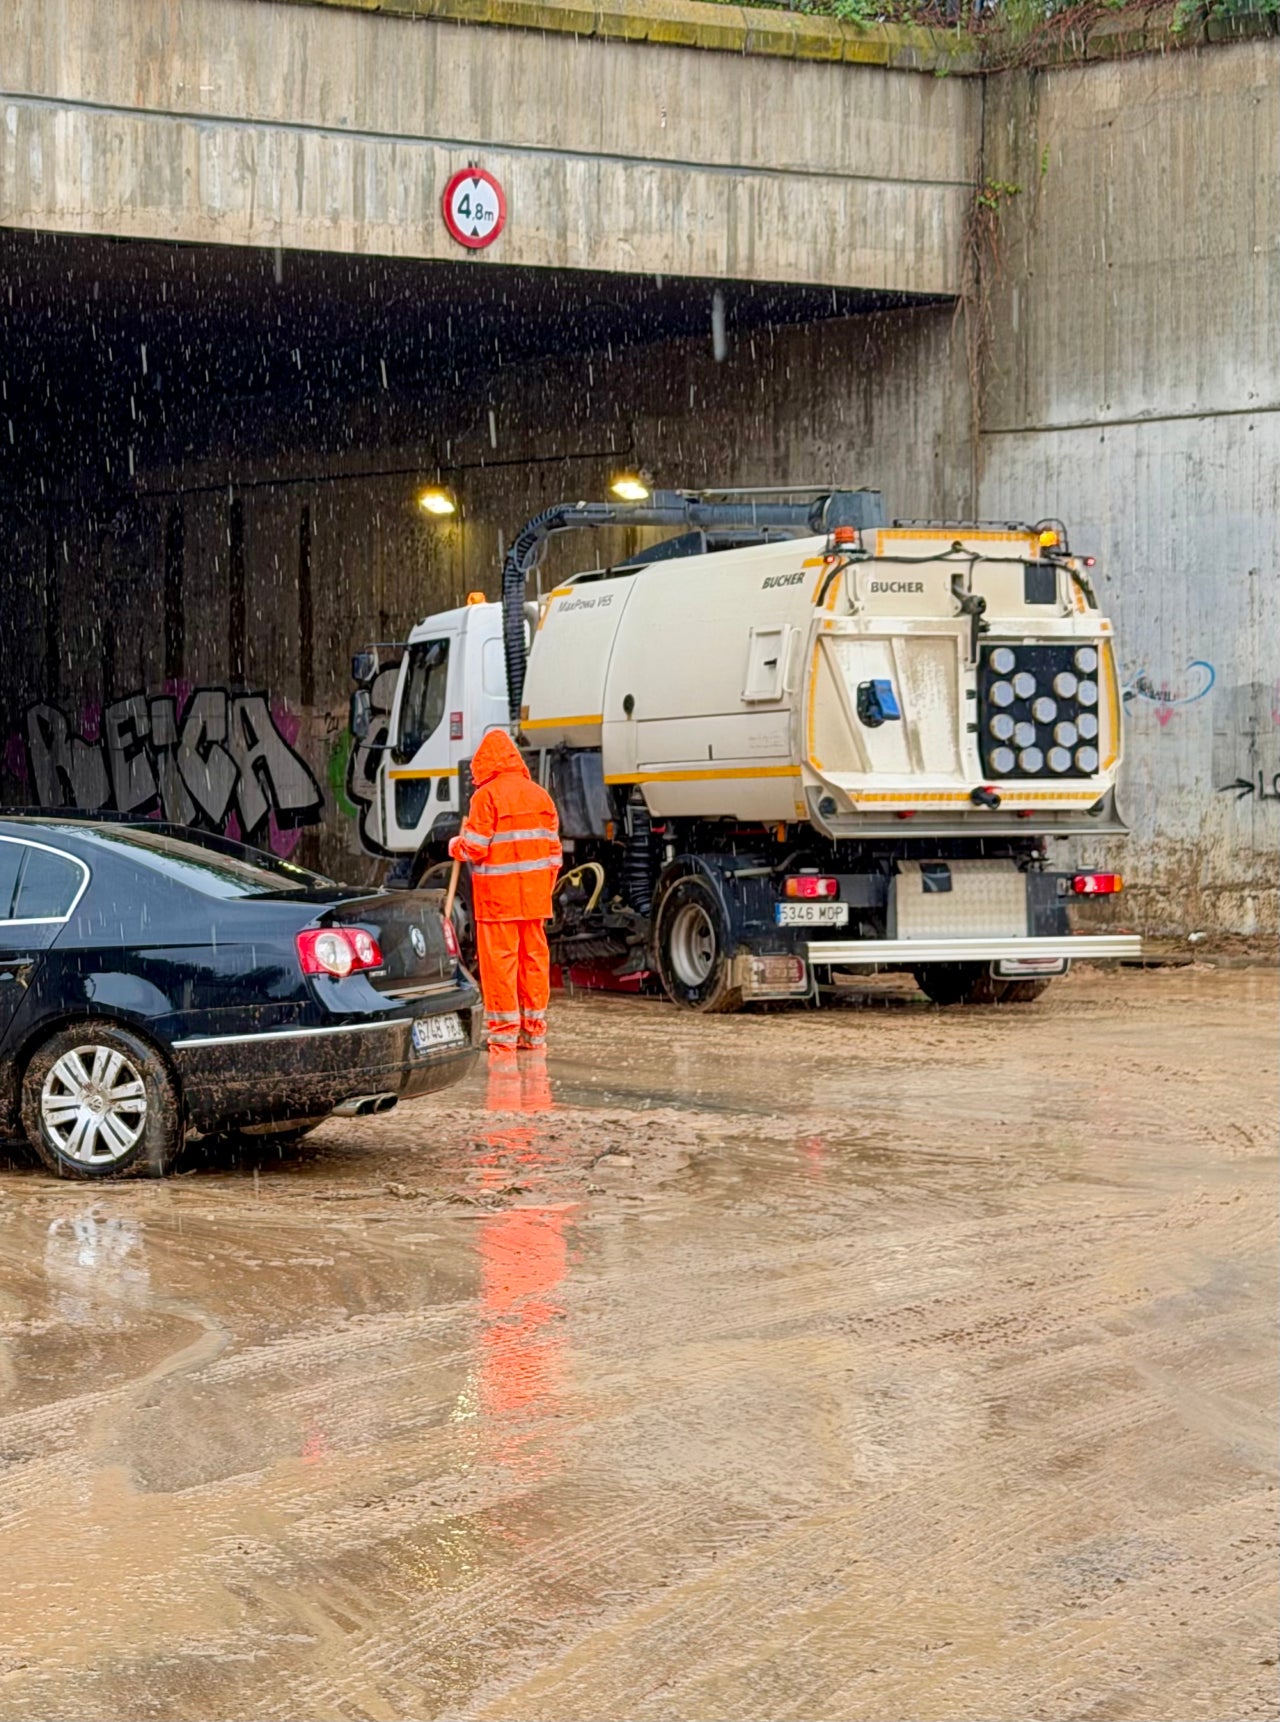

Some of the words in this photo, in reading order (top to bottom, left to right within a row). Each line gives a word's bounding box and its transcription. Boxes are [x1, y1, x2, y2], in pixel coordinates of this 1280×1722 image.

[762, 572, 806, 589] BUCHER
[871, 581, 925, 593] BUCHER
[781, 906, 815, 921] 5346
